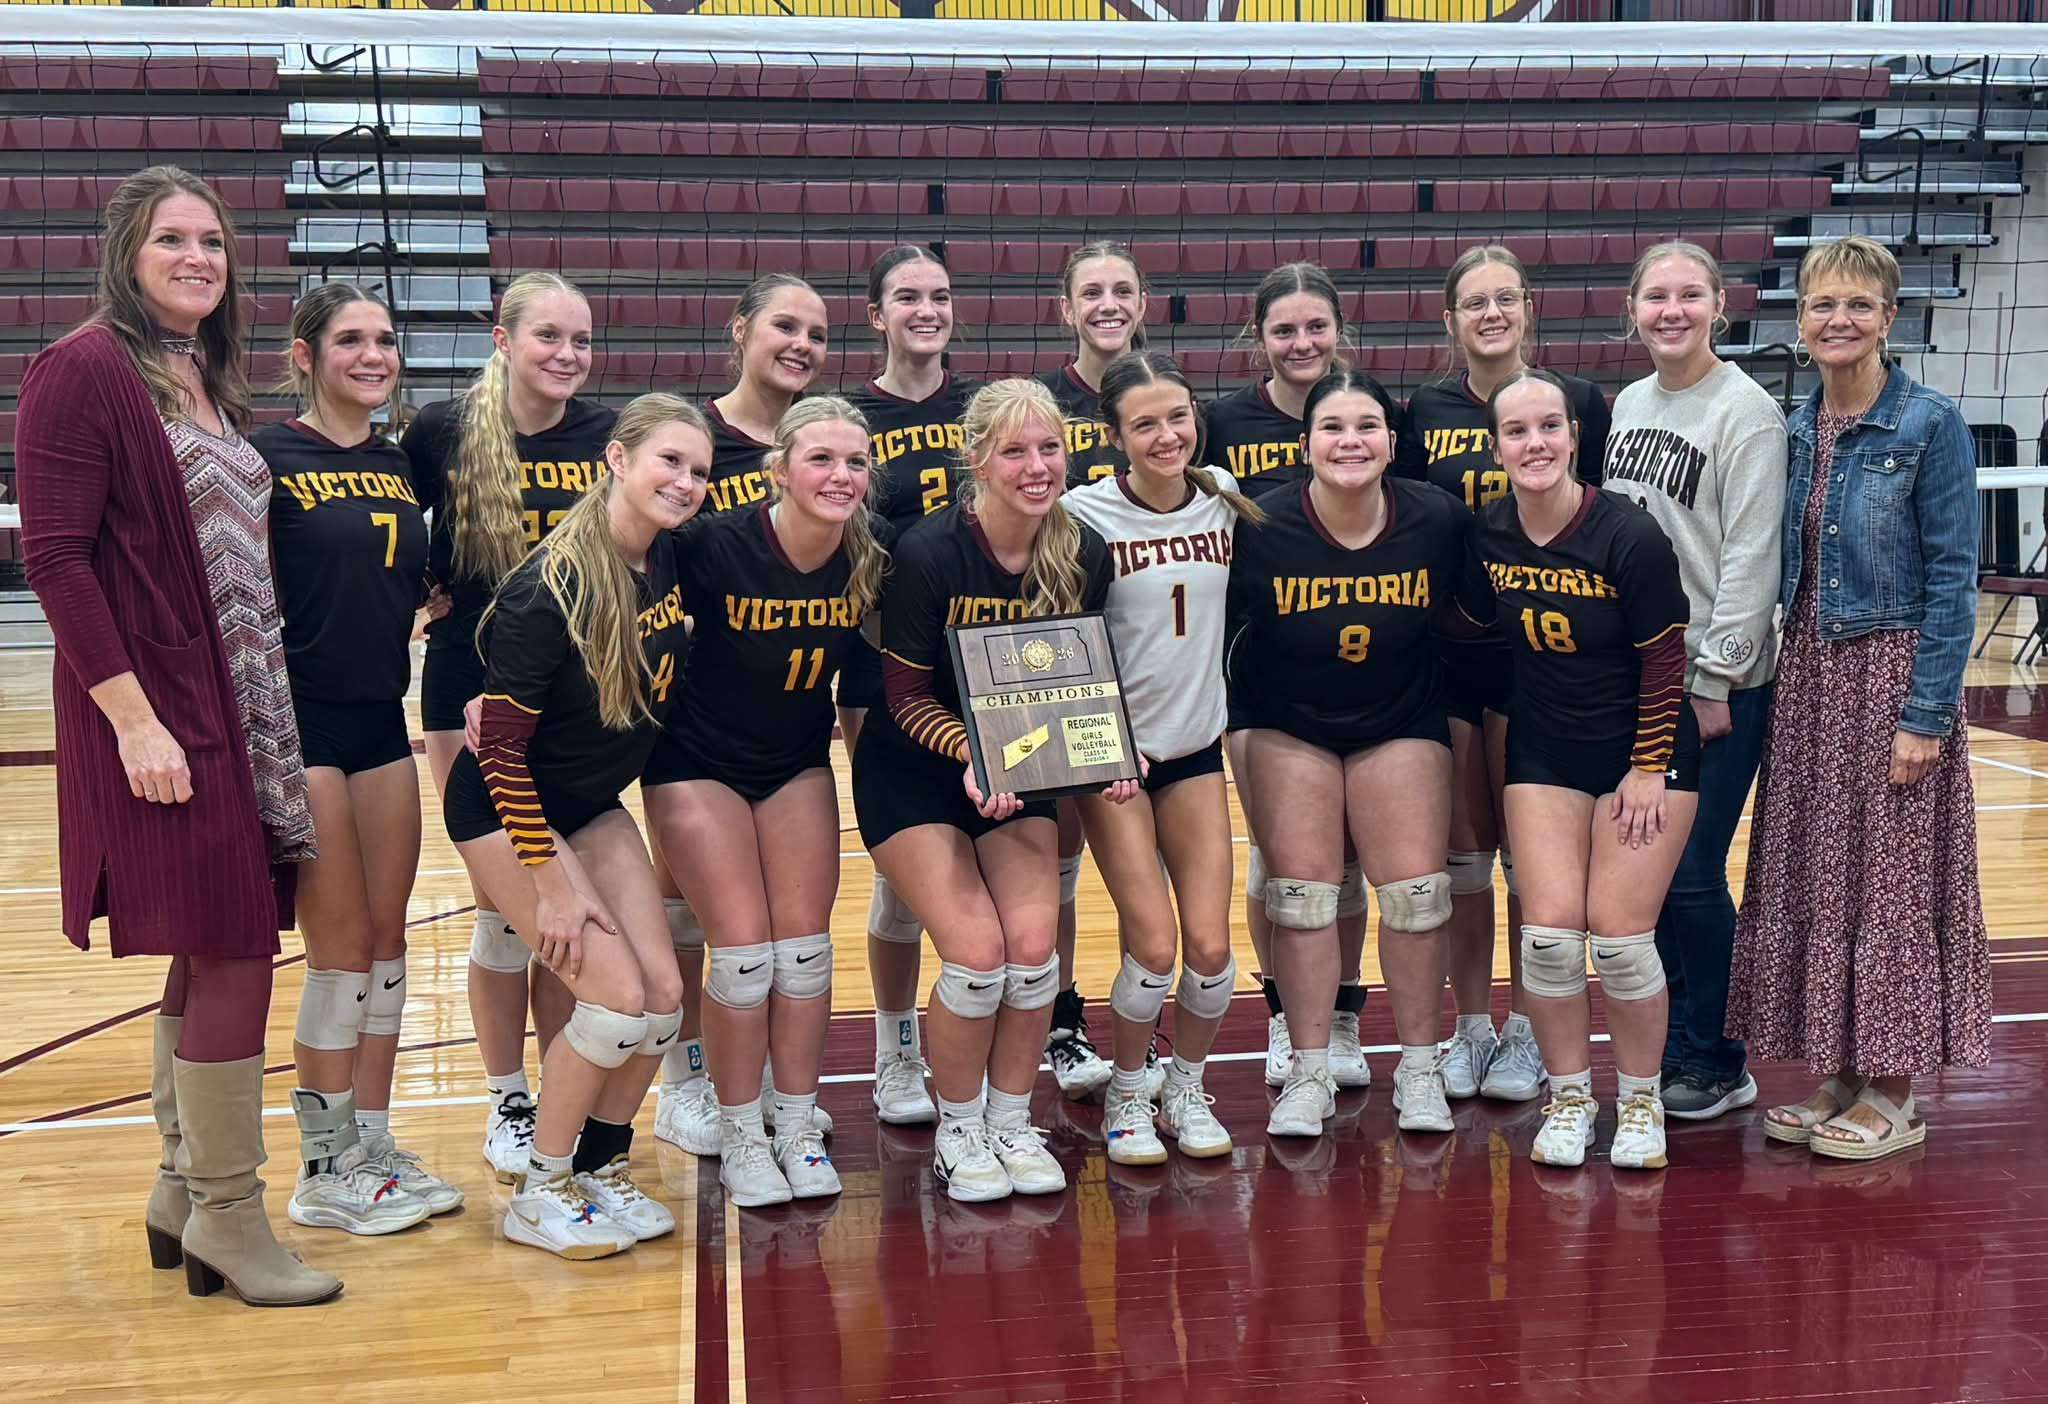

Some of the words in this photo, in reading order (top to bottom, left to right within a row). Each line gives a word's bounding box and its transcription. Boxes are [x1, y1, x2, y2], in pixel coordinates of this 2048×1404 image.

[1226, 442, 1300, 479] VICT
[1424, 427, 1490, 465] VICT
[919, 466, 949, 516] 2
[369, 511, 398, 568] 7
[1273, 568, 1430, 615] VICTORIA
[725, 594, 861, 631] VICTORI
[1169, 582, 1189, 640] 1
[1337, 624, 1371, 663] 8
[1520, 608, 1577, 653] 18
[783, 647, 825, 691] 11
[986, 685, 1105, 708] CHAMPIONS
[1067, 716, 1111, 730] REGIONAL
[1081, 731, 1103, 741] GIRLS
[1071, 739, 1117, 751] VOLLEYBALL
